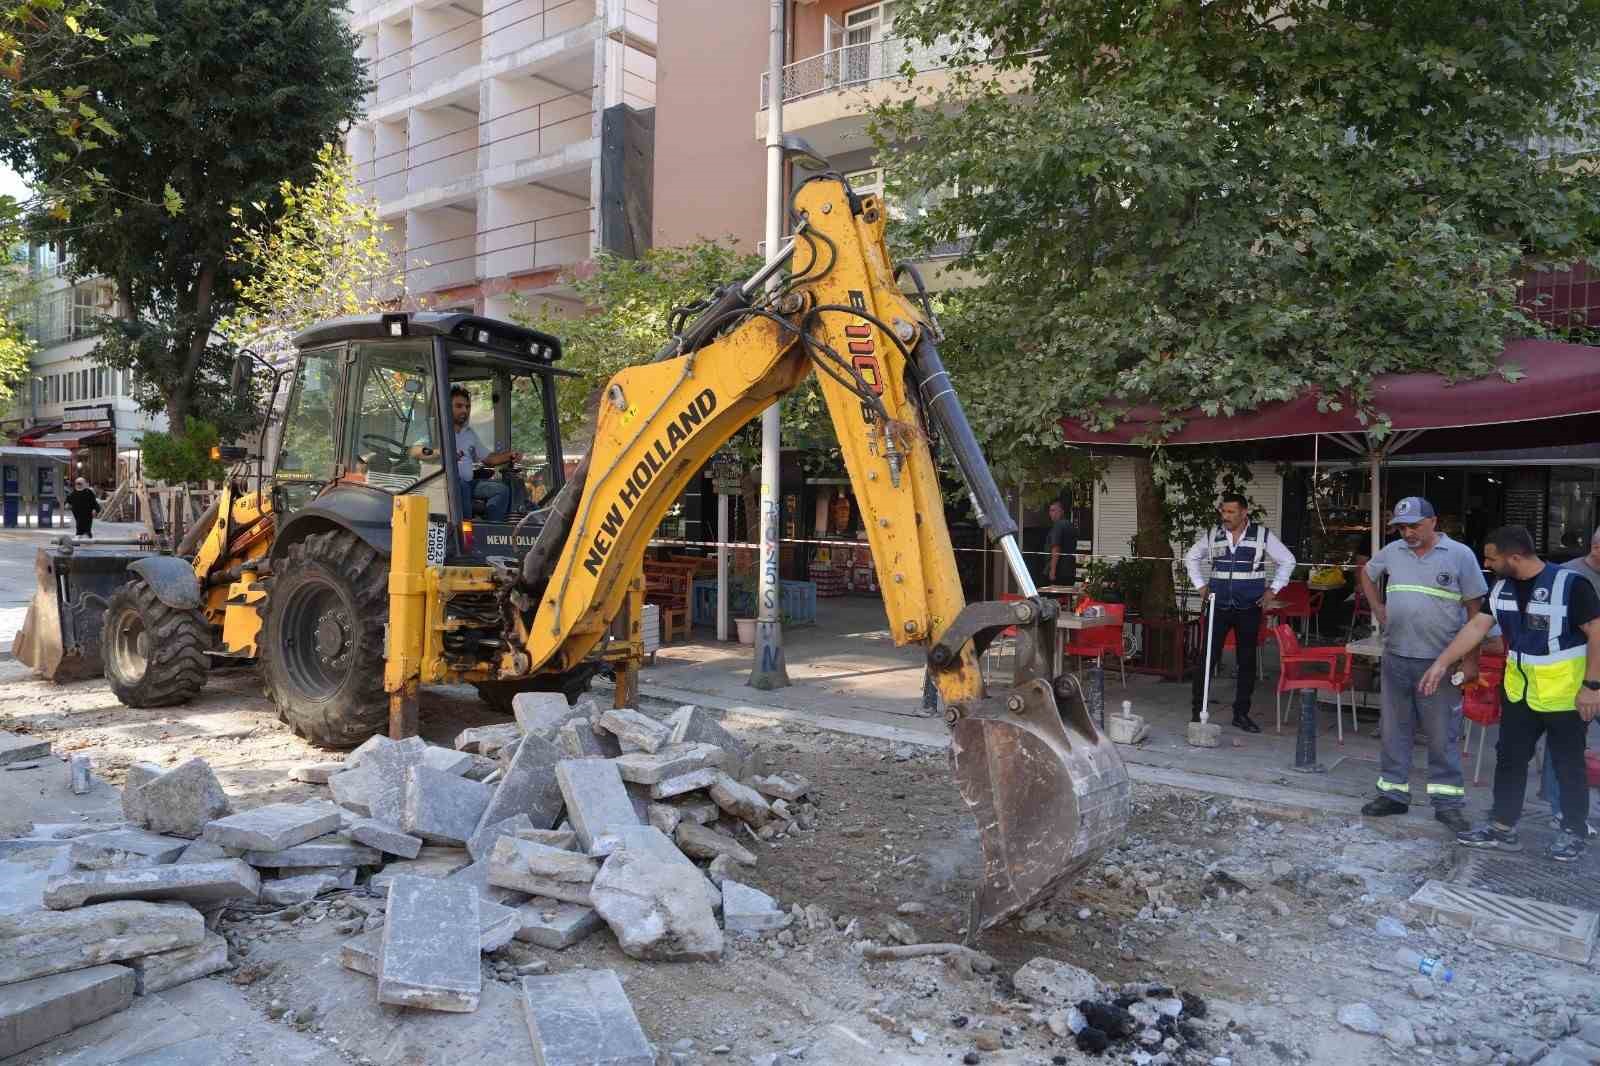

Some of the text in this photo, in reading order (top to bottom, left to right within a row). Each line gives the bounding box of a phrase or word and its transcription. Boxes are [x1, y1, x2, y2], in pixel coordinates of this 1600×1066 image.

[583, 388, 717, 577] NEW HOLLAND
[486, 535, 508, 545] NEW
